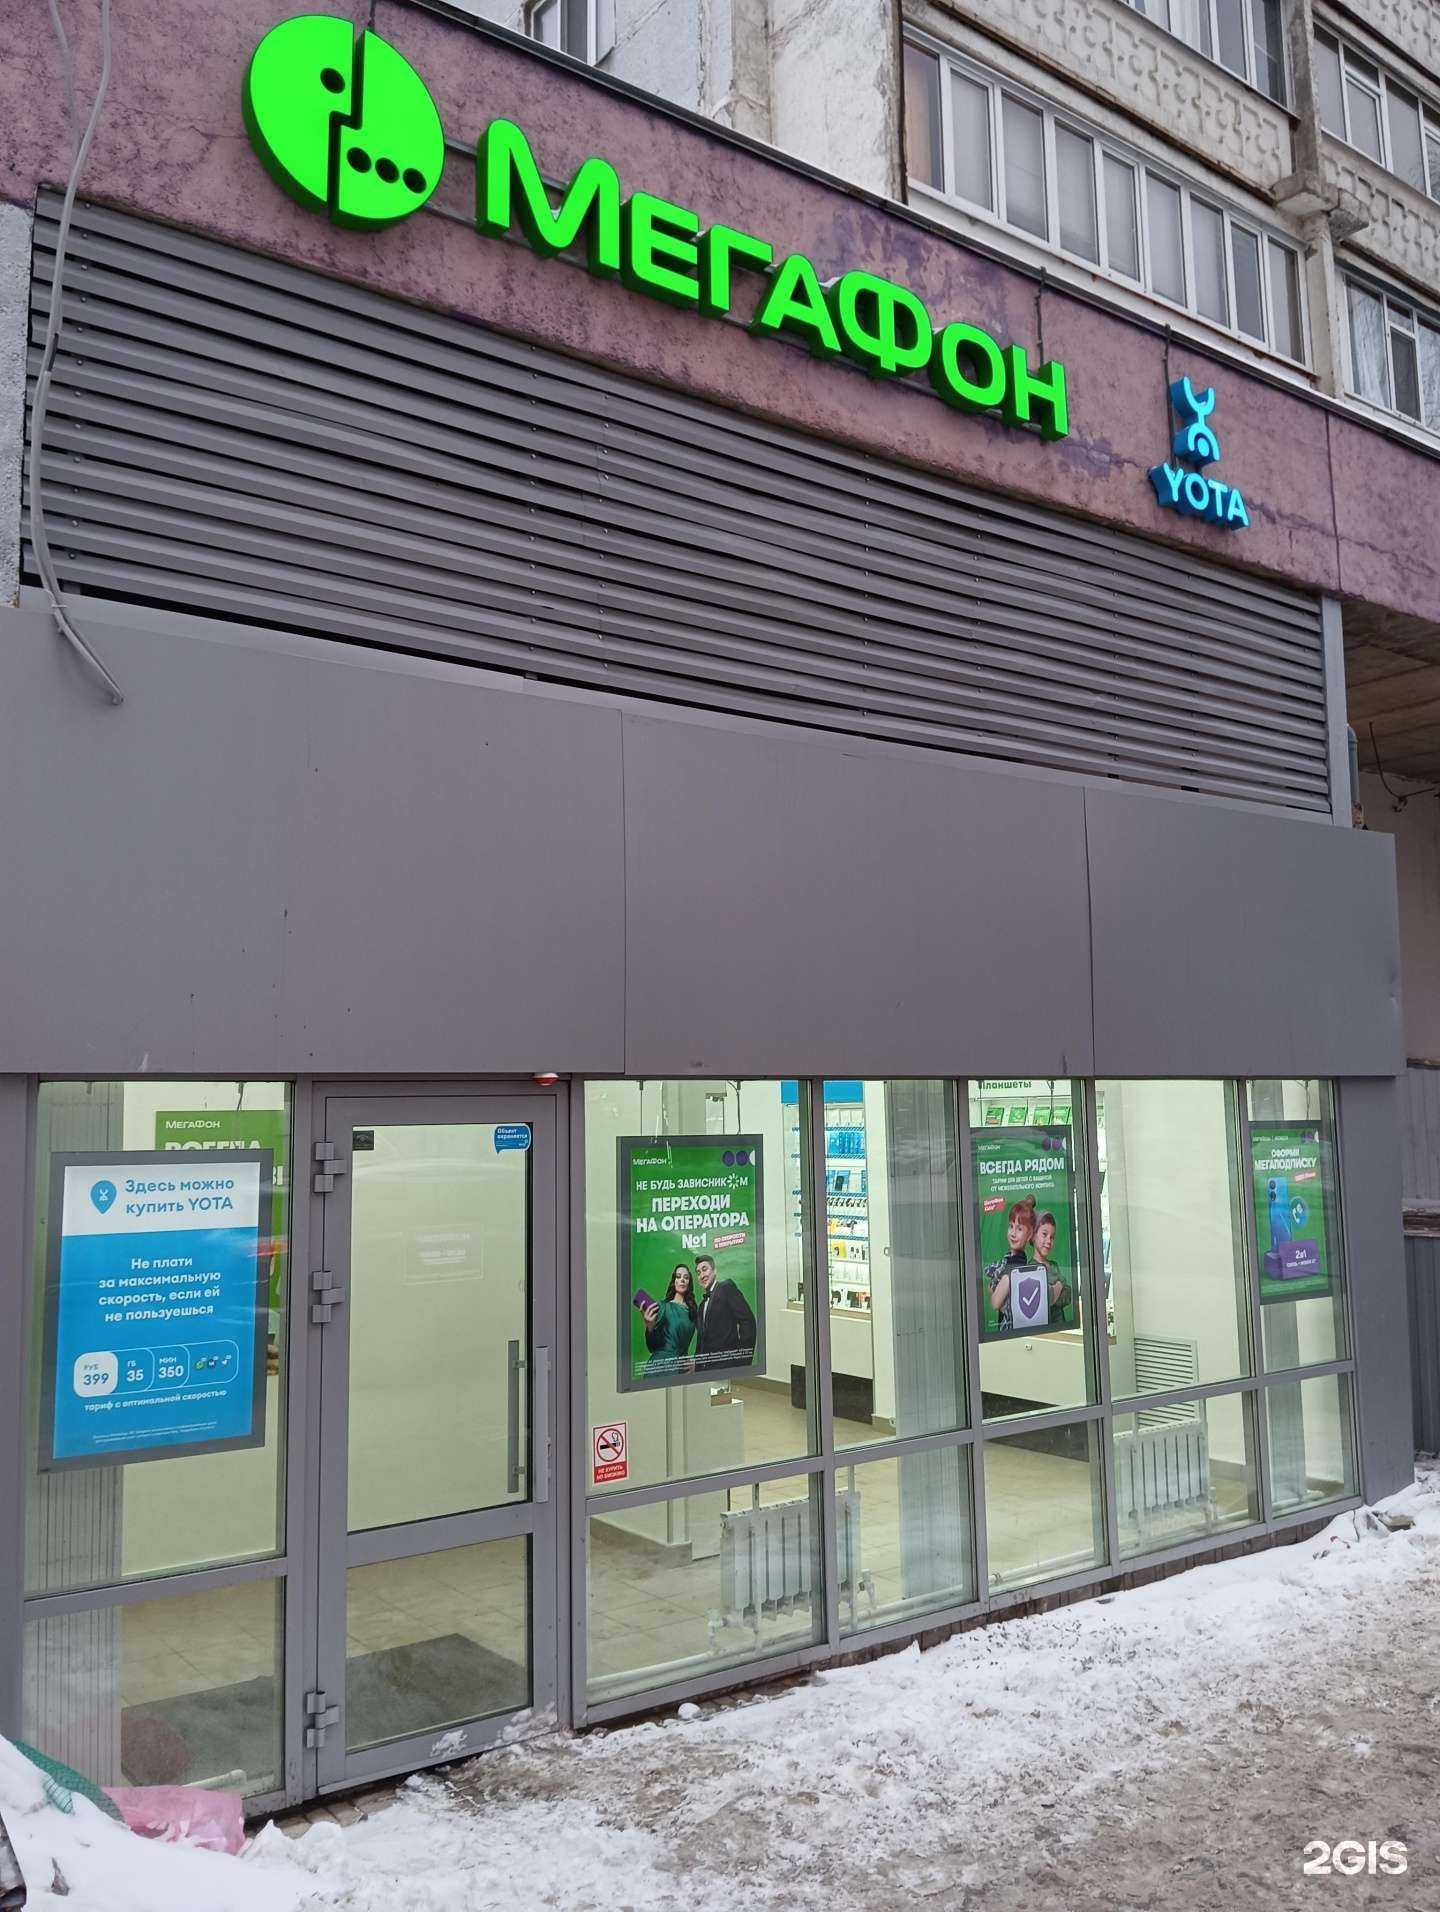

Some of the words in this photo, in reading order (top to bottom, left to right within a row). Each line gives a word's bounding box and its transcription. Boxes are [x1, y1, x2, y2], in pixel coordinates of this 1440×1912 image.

[1153, 461, 1249, 529] YOTA
[980, 1160, 1023, 1175] ВСЕГДА
[1024, 1157, 1065, 1173] РЯДОМ
[125, 1179, 176, 1193] Здесь
[180, 1179, 235, 1191] можно
[636, 1181, 648, 1191] НЕ
[650, 1180, 675, 1190] БУДЬ
[126, 1200, 184, 1217] купить
[188, 1196, 234, 1211] YOTA
[652, 1194, 731, 1212] ПЕРЕХОДИ
[636, 1217, 658, 1233] НА
[661, 1212, 750, 1231] ОПЕРАТОРА
[131, 1258, 150, 1270] Не
[153, 1256, 193, 1268] плати
[98, 1278, 115, 1288] за
[119, 1271, 221, 1288] максимальную
[98, 1293, 166, 1306] скорость,
[169, 1288, 201, 1300] если
[204, 1285, 220, 1297] ей
[105, 1312, 123, 1322] не
[126, 1304, 214, 1321] пользуешься
[83, 1372, 110, 1386] 399
[126, 1369, 145, 1382] 35
[158, 1365, 185, 1379] 350
[84, 1401, 114, 1412] тариф
[122, 1393, 181, 1408] оптимальной
[182, 1389, 228, 1401] скоростью
